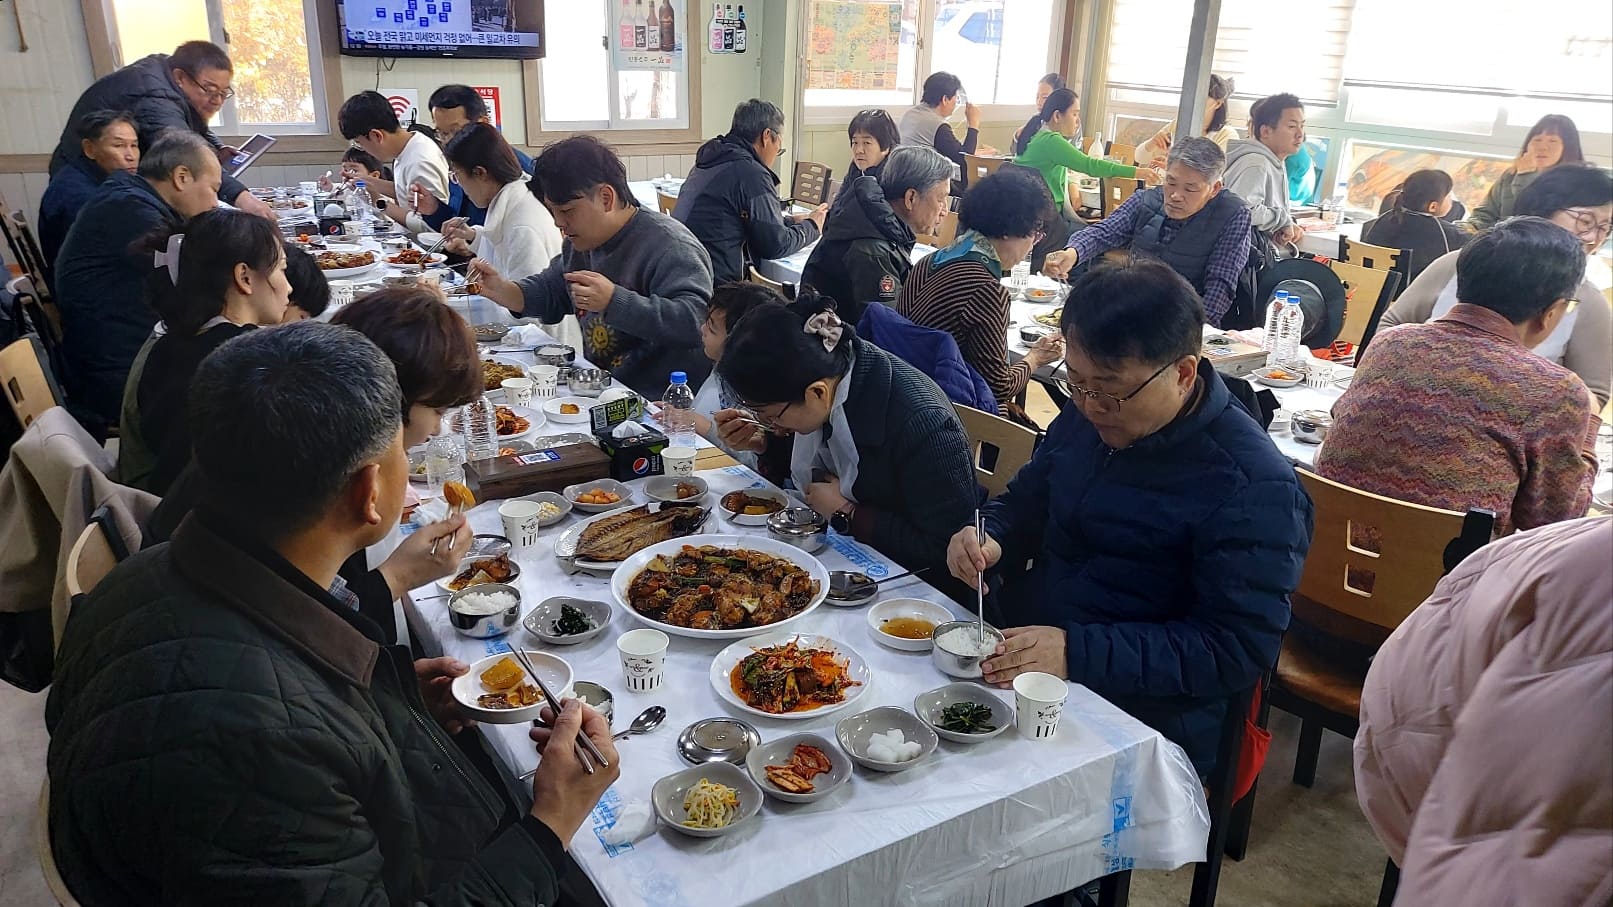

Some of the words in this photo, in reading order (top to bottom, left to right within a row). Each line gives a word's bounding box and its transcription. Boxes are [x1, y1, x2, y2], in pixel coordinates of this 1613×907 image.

[367, 30, 382, 41] 오늘
[383, 31, 398, 42] 전국
[399, 31, 413, 42] 맑고
[415, 31, 442, 43] 미세먼지
[443, 32, 458, 43] 걱정
[486, 33, 506, 44] 일교차
[507, 34, 520, 44] 유의
